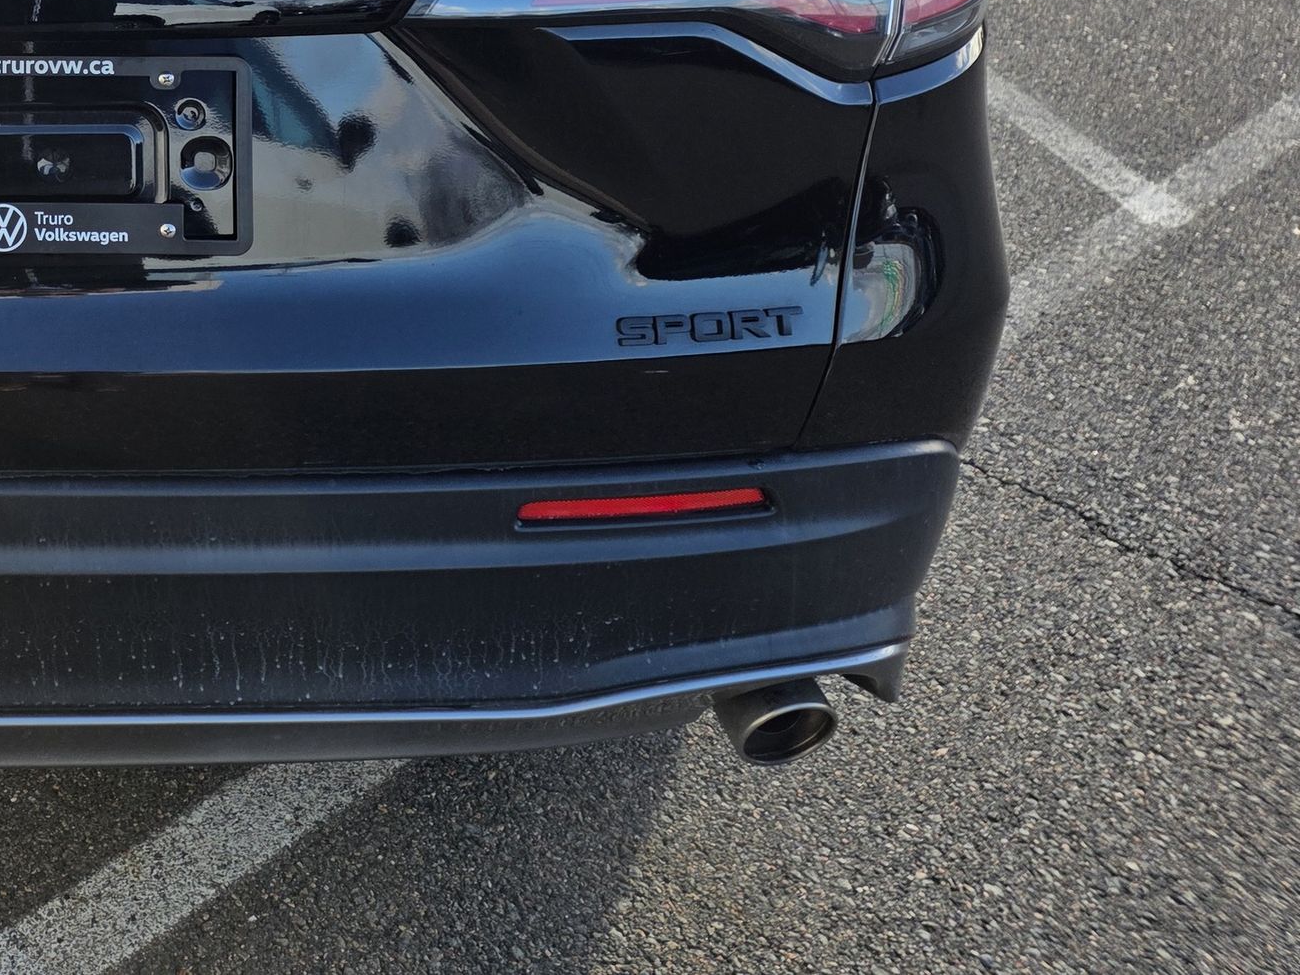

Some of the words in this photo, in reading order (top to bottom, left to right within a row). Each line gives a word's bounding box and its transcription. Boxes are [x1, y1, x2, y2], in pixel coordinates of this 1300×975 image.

[34, 211, 74, 225] Truro
[34, 228, 129, 245] Volkswagen
[616, 305, 804, 347] SPORT
